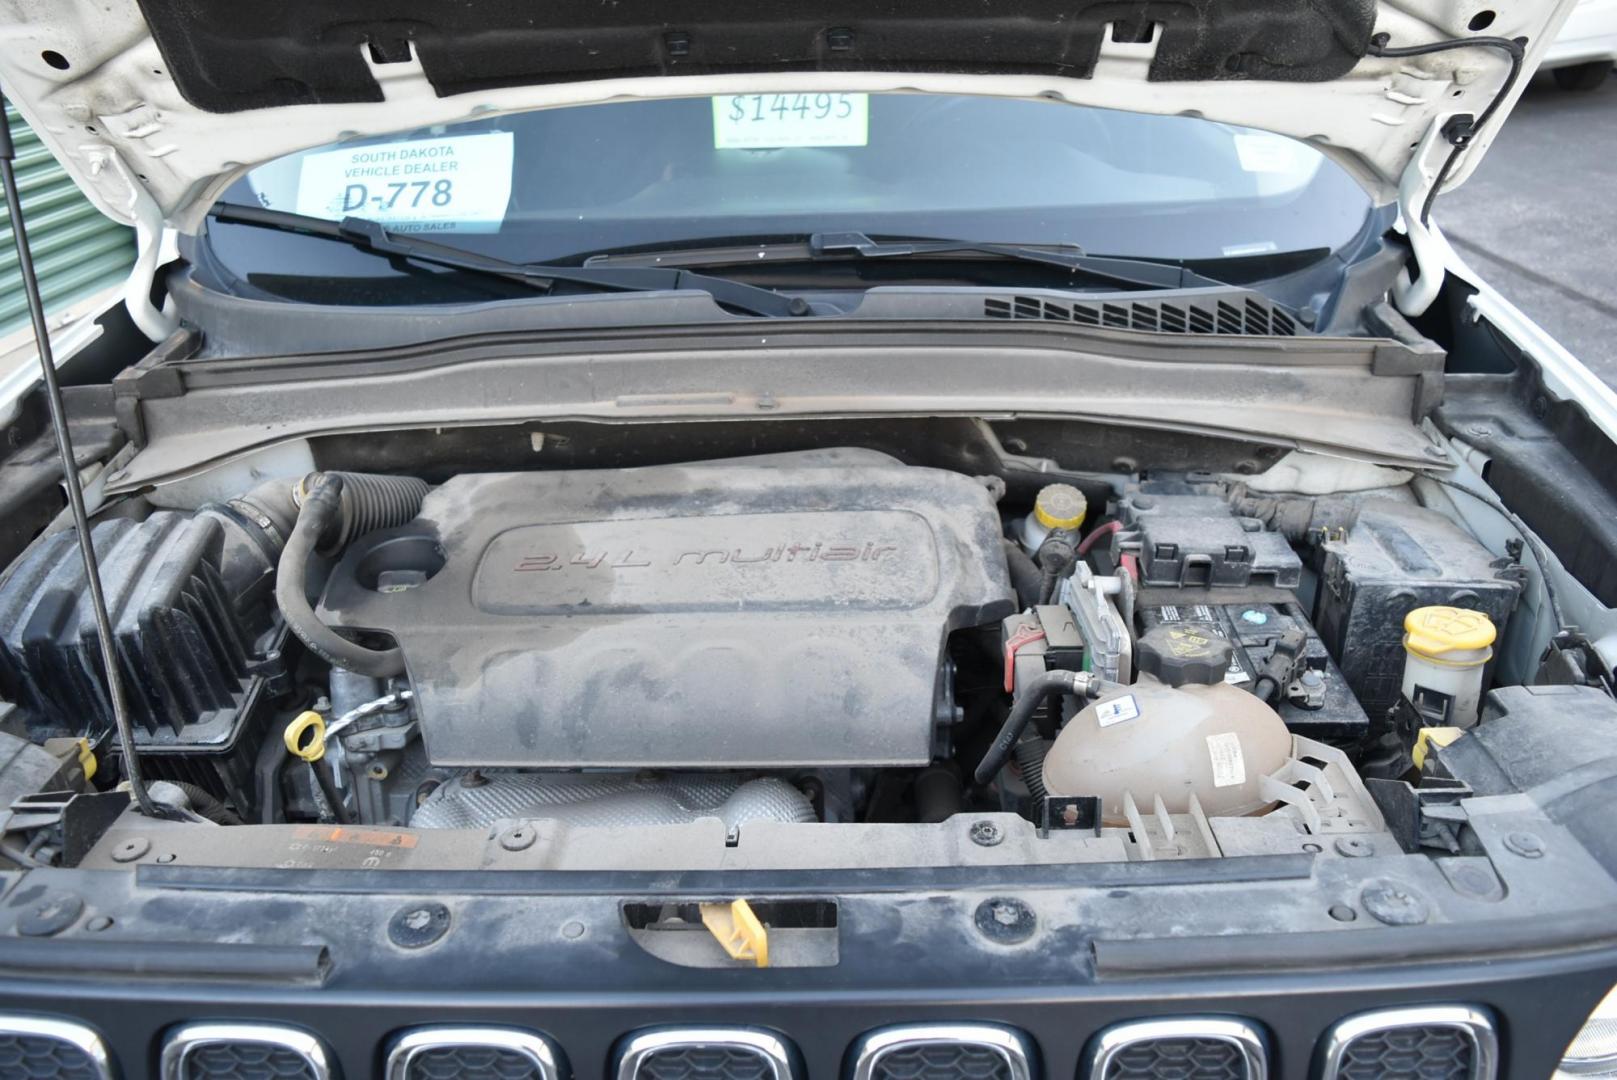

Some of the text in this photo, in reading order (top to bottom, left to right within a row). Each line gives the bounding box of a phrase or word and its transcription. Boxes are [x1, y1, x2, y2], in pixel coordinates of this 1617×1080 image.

[728, 93, 852, 123] $14495
[351, 145, 455, 164] SOUTH DAKOTA
[344, 160, 459, 178] VEHICLE DEALER
[342, 179, 453, 212] D-778
[393, 221, 456, 233] AUTO SALES
[513, 550, 651, 572] 2.4L
